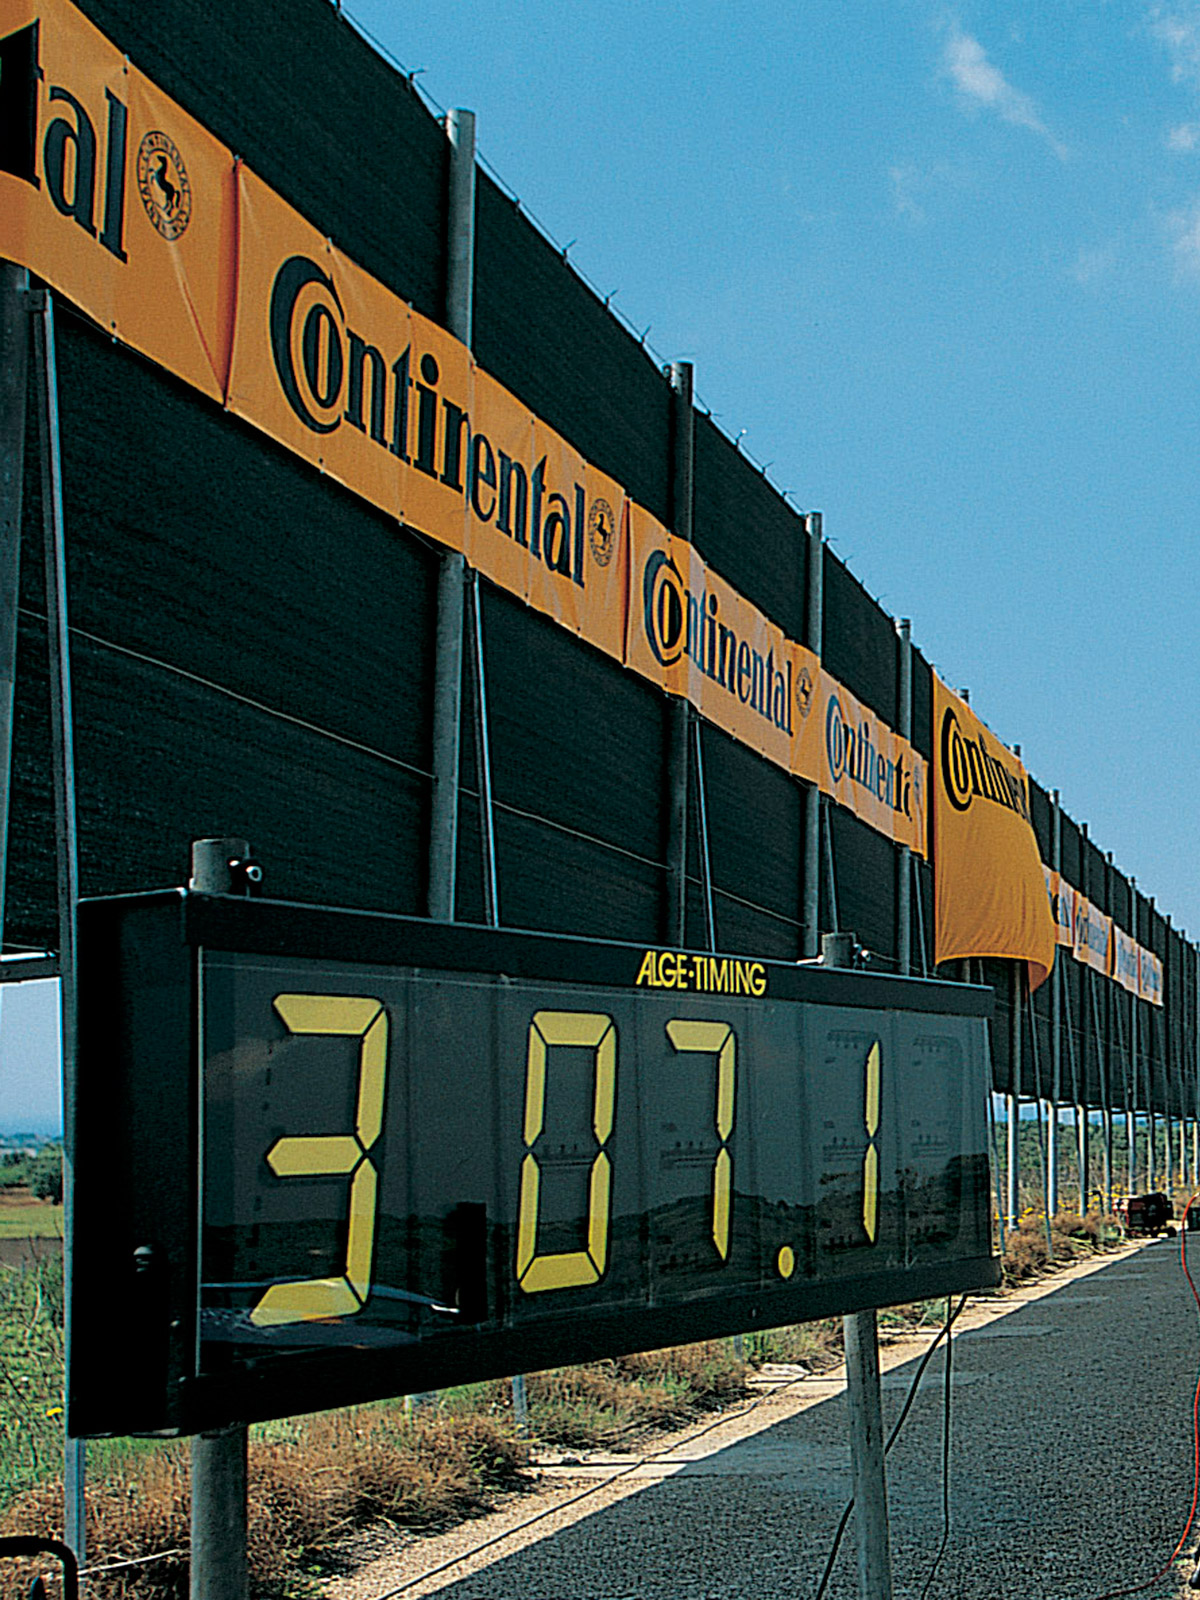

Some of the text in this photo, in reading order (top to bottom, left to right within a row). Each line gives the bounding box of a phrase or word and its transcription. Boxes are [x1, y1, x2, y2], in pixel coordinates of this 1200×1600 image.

[269, 254, 585, 589] Continental
[643, 549, 794, 737] Continental
[826, 694, 913, 822] Continent
